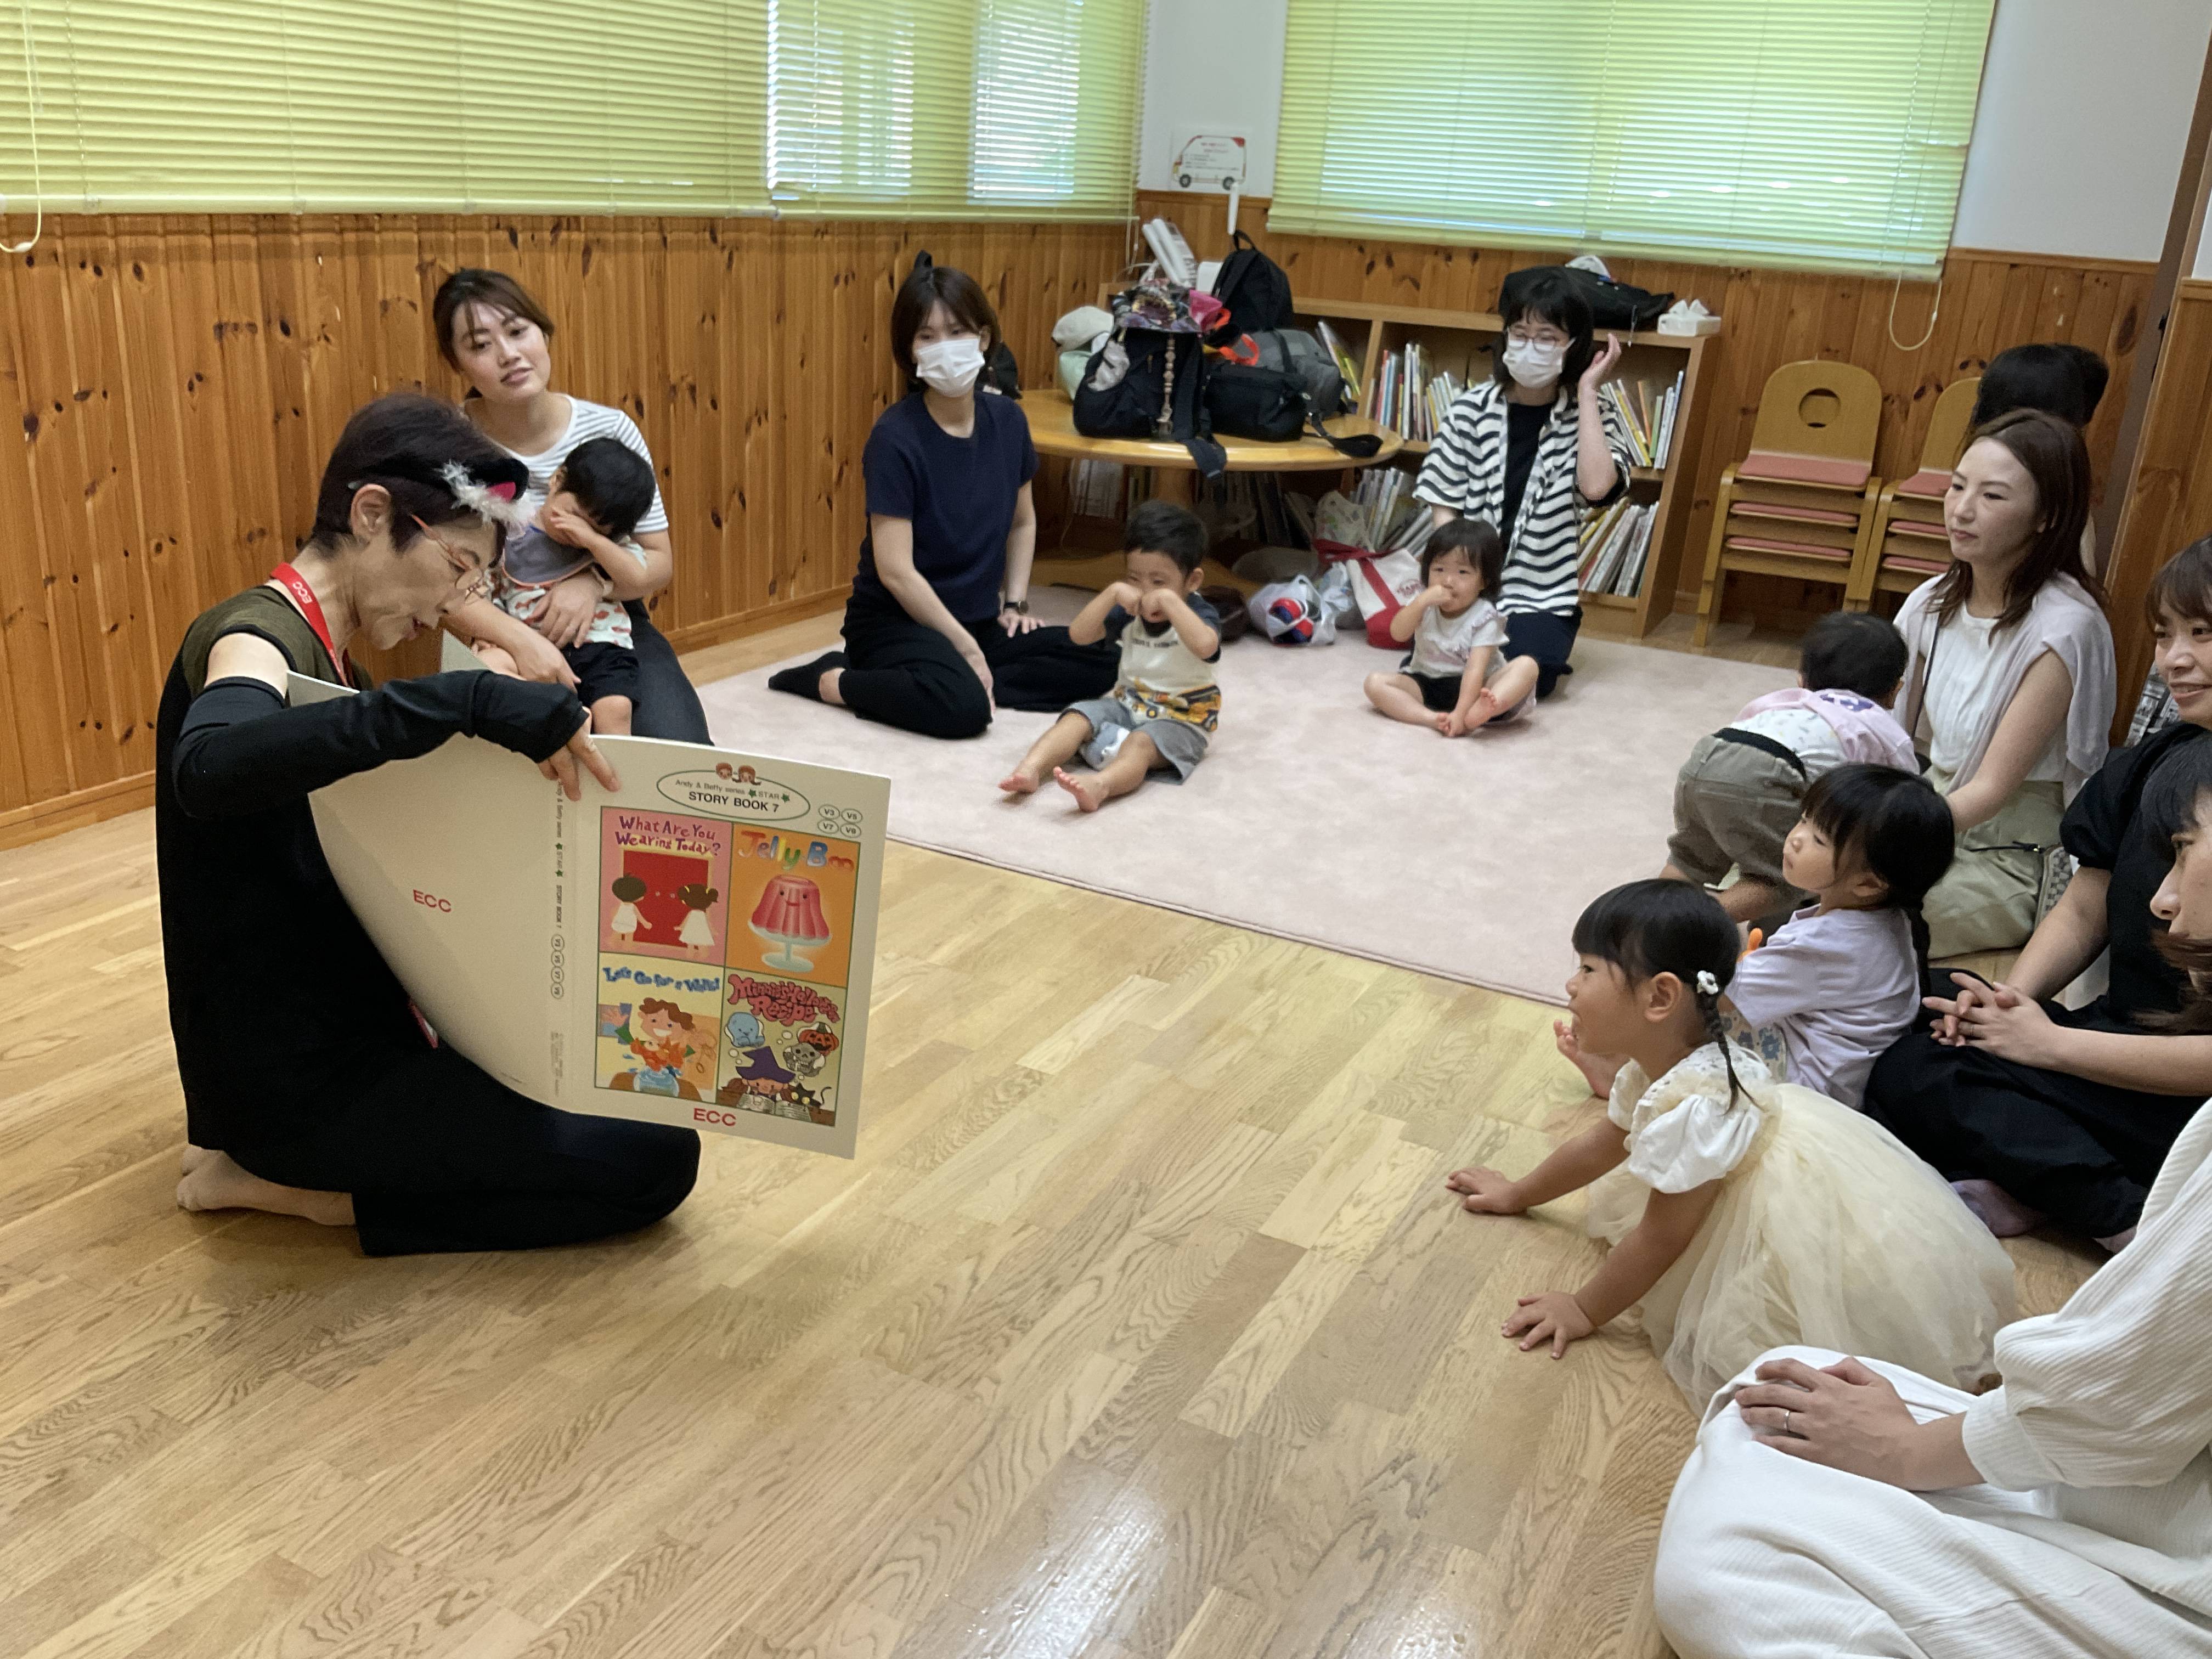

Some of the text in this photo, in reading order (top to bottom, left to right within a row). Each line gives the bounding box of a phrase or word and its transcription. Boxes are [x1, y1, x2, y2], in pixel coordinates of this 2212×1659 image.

[292, 581, 312, 604] ECC
[675, 780, 693, 788] Andy
[758, 791, 780, 799] STAR
[689, 792, 780, 813] STORY BOOK 7
[619, 815, 716, 840] What Are You
[823, 822, 834, 830] V7
[615, 831, 721, 857] Wearing Today?
[413, 889, 452, 913] ECC
[634, 970, 652, 984] Go
[747, 995, 817, 1026] Recipe
[693, 1108, 736, 1126] ECC
